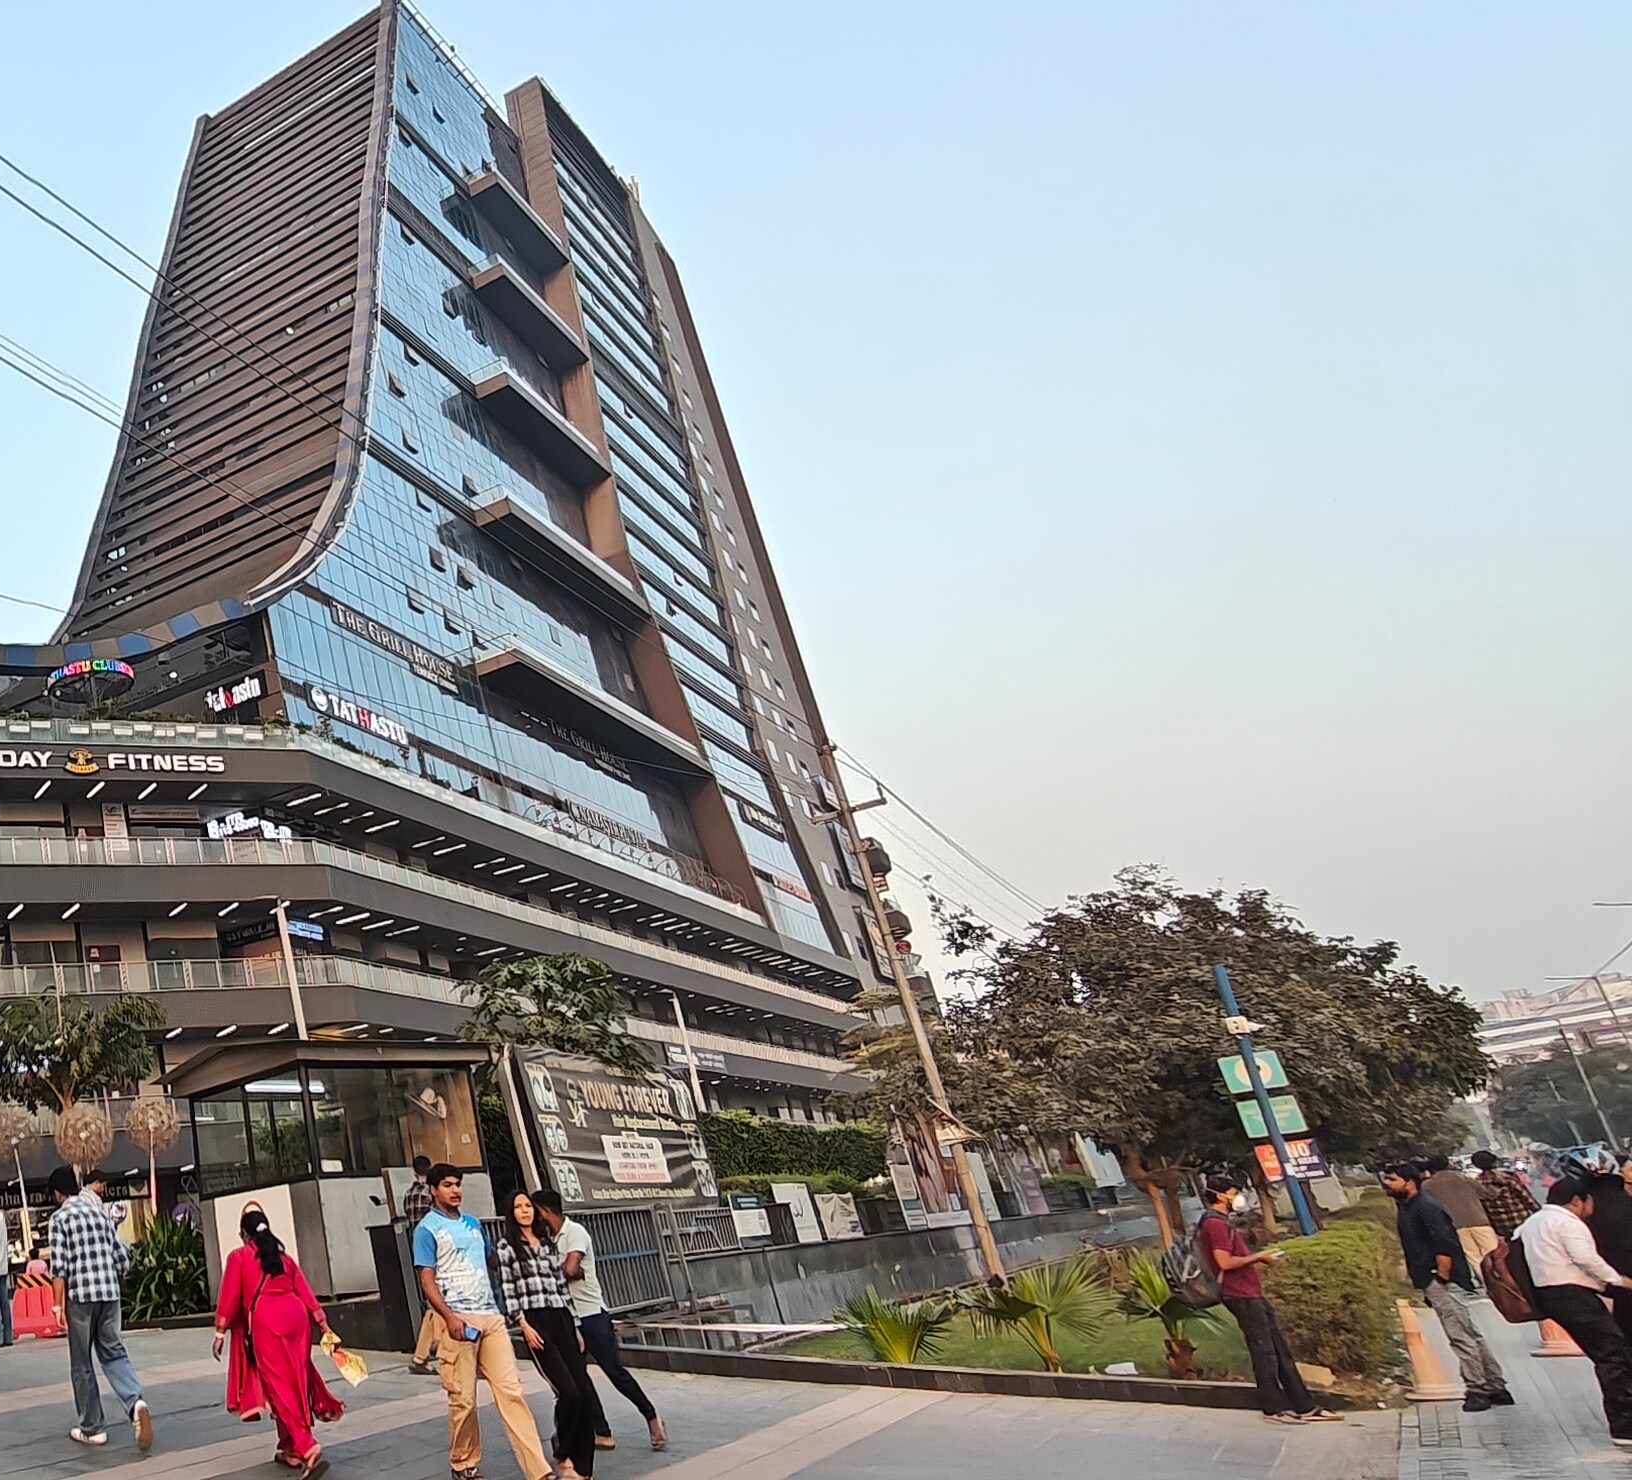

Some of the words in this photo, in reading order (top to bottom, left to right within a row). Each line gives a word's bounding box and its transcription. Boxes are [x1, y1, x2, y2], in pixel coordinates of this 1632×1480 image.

[332, 600, 365, 635] THE
[368, 621, 410, 659] GRILL
[411, 644, 456, 682] HOUSE
[328, 694, 409, 745] TATHASTU
[107, 752, 225, 773] FITNESS
[578, 1079, 623, 1112] YOUNG
[620, 1084, 674, 1116] FOREVER
